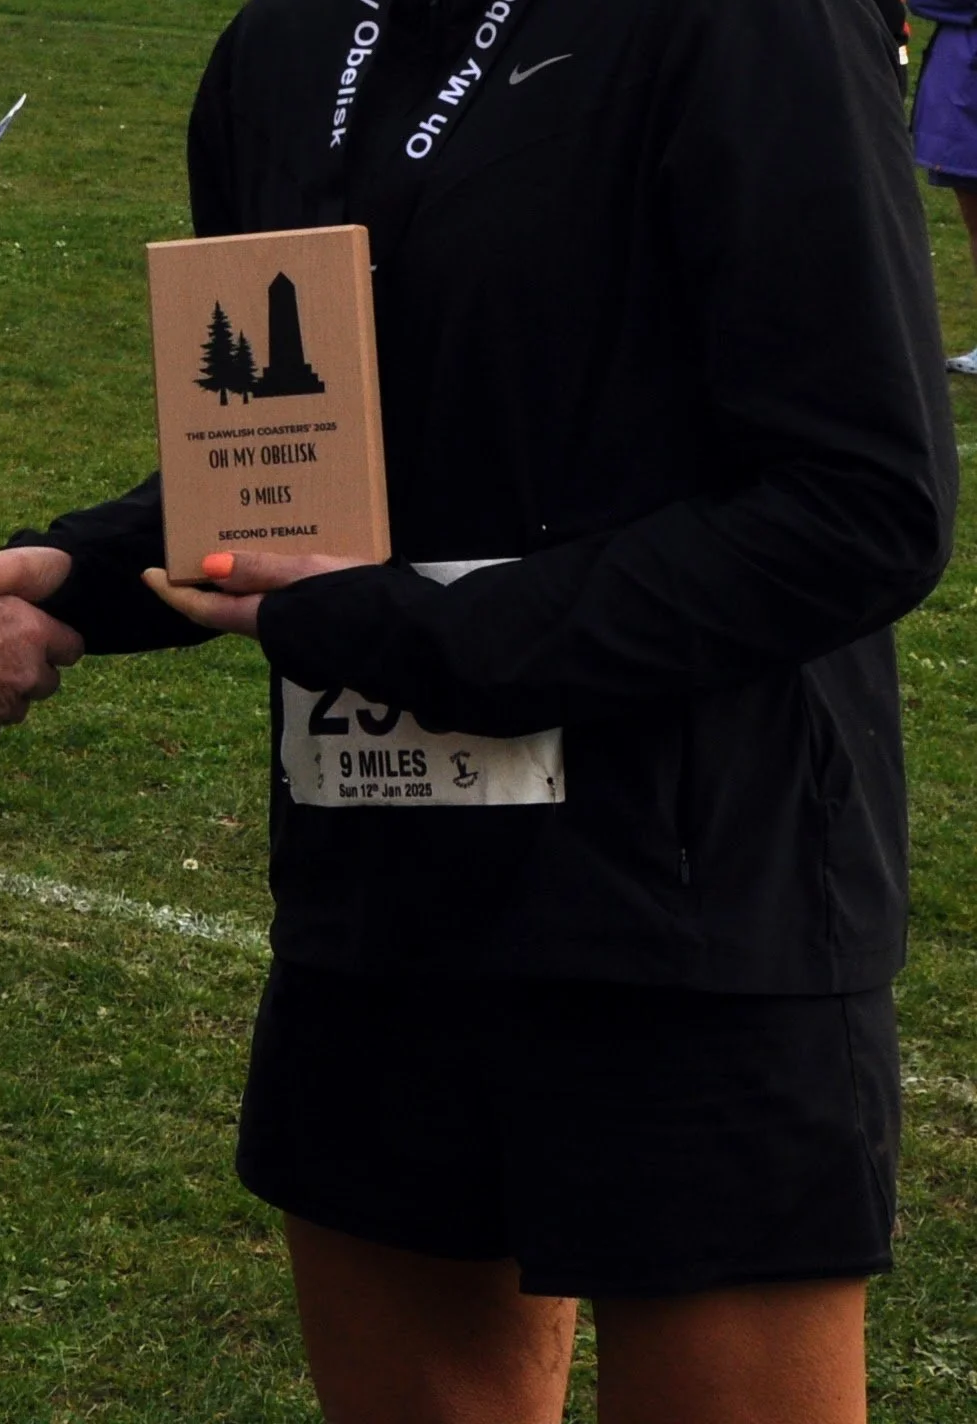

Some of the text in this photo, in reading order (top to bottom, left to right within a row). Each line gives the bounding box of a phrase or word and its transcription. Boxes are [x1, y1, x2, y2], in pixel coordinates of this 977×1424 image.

[330, 20, 380, 149] Obelisk
[406, 113, 448, 159] Oh
[438, 57, 483, 106] My
[187, 432, 205, 441] THE
[208, 428, 255, 440] DAWLISH
[313, 422, 337, 433] 2025
[209, 443, 317, 469] OH MY OBELISK
[240, 485, 291, 506] 9 MILES
[218, 524, 318, 541] SECOND FEMALE
[339, 750, 352, 778] 9
[358, 749, 427, 778] MILES
[339, 783, 358, 798] Sun
[382, 783, 402, 797] Jan
[404, 782, 433, 797] 2025
